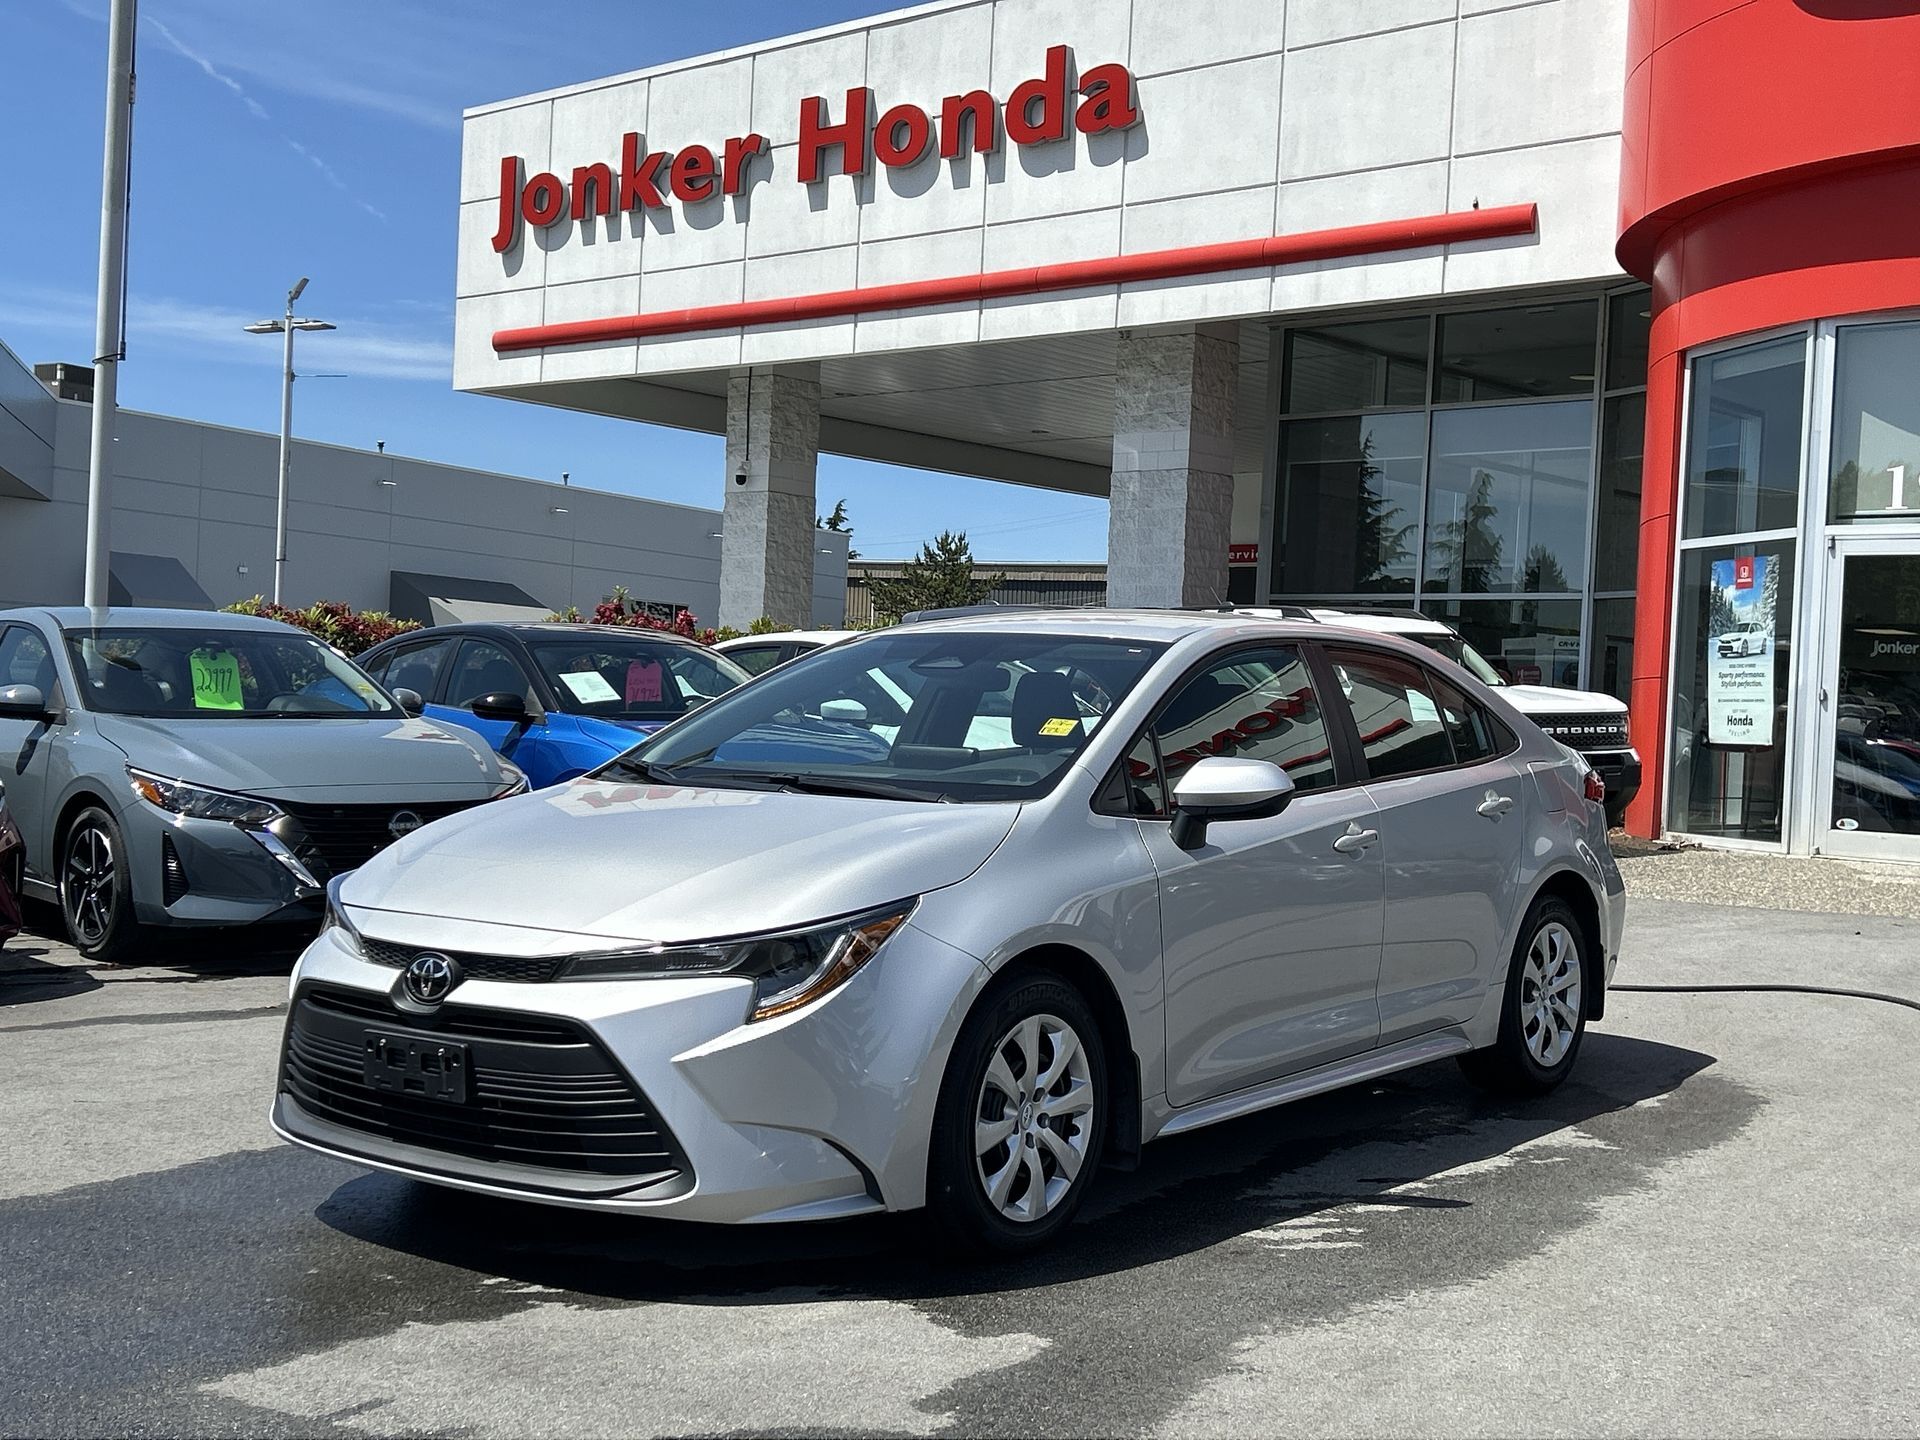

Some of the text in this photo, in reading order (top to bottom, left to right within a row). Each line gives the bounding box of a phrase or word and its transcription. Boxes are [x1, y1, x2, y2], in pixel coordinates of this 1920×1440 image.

[491, 45, 1140, 253] Jonker Honda
[1885, 465, 1920, 509] 1
[1870, 640, 1920, 657] Jonker
[1718, 671, 1733, 679] Sporty
[1721, 680, 1736, 688] Stylish
[1727, 715, 1753, 726] Honda
